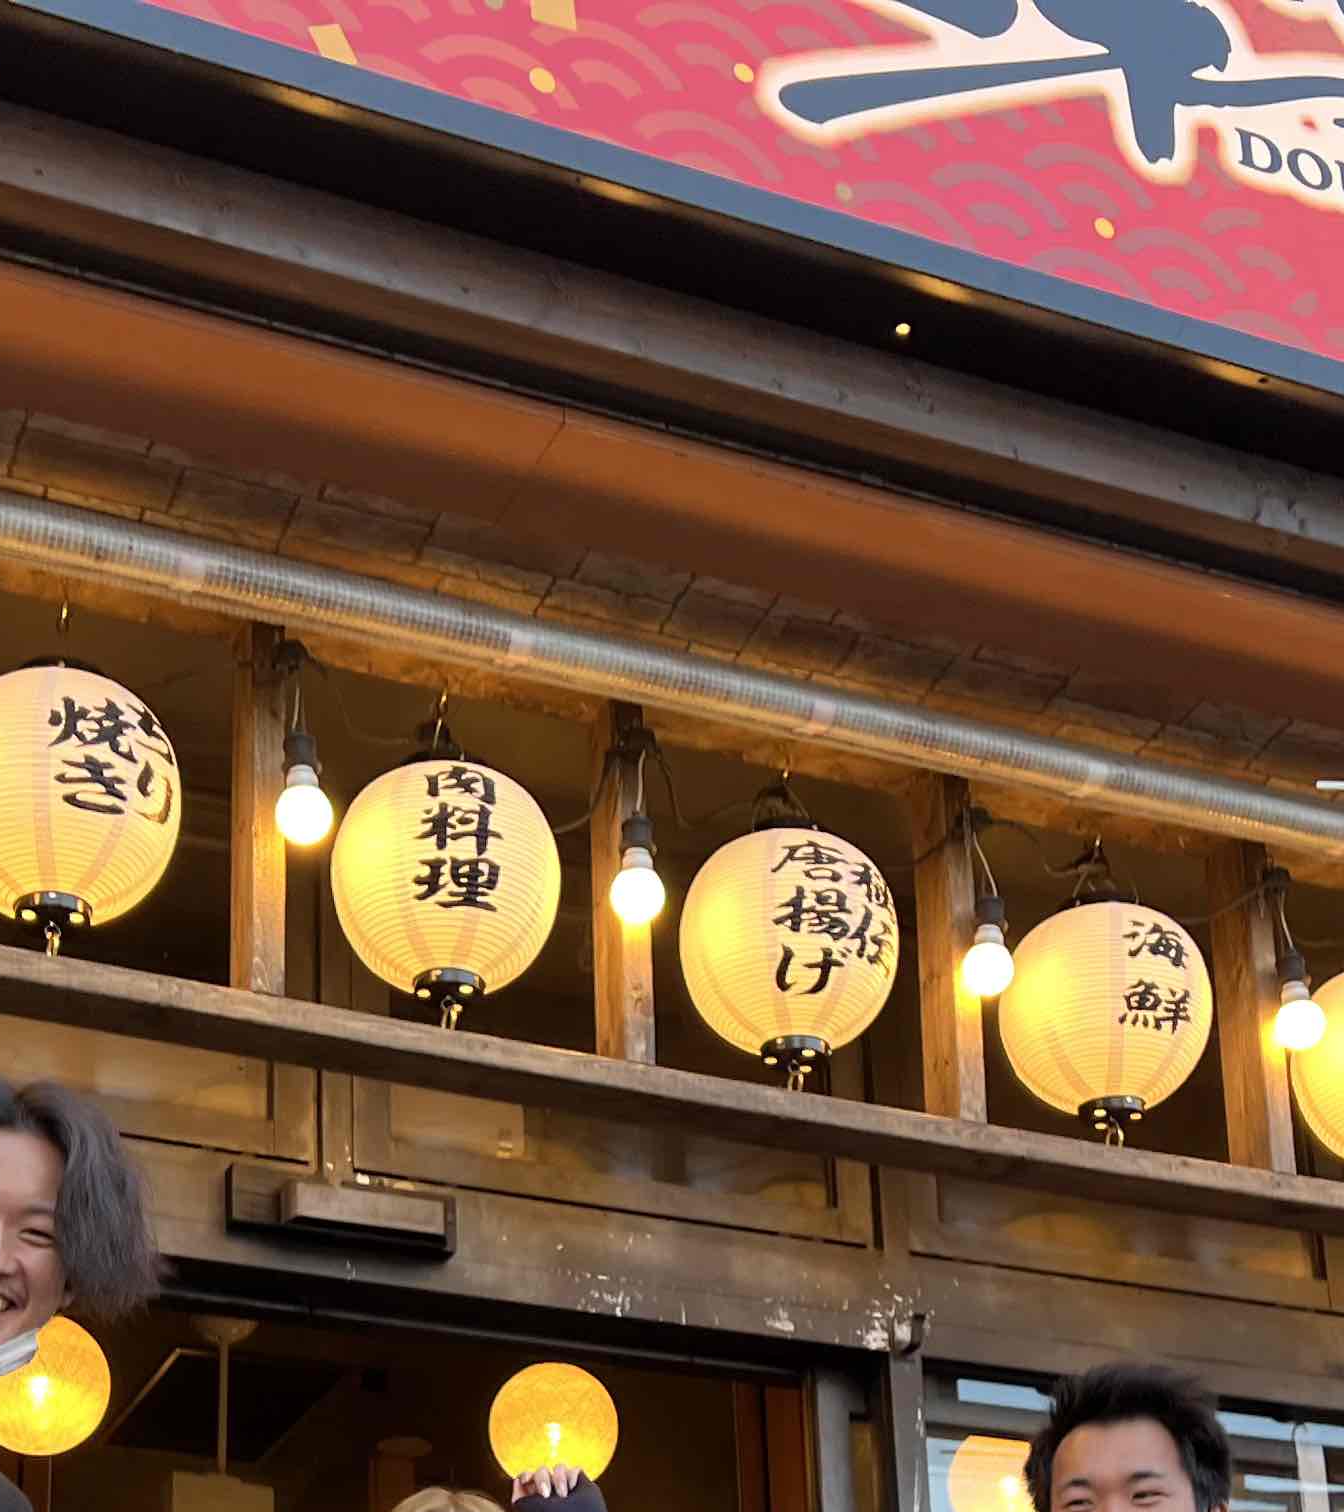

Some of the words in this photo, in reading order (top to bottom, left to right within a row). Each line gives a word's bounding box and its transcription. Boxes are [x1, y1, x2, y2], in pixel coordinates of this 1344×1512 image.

[413, 765, 504, 913] 肉料理
[771, 839, 852, 995] 唐揚げ
[1118, 920, 1191, 1034] 海鮮
